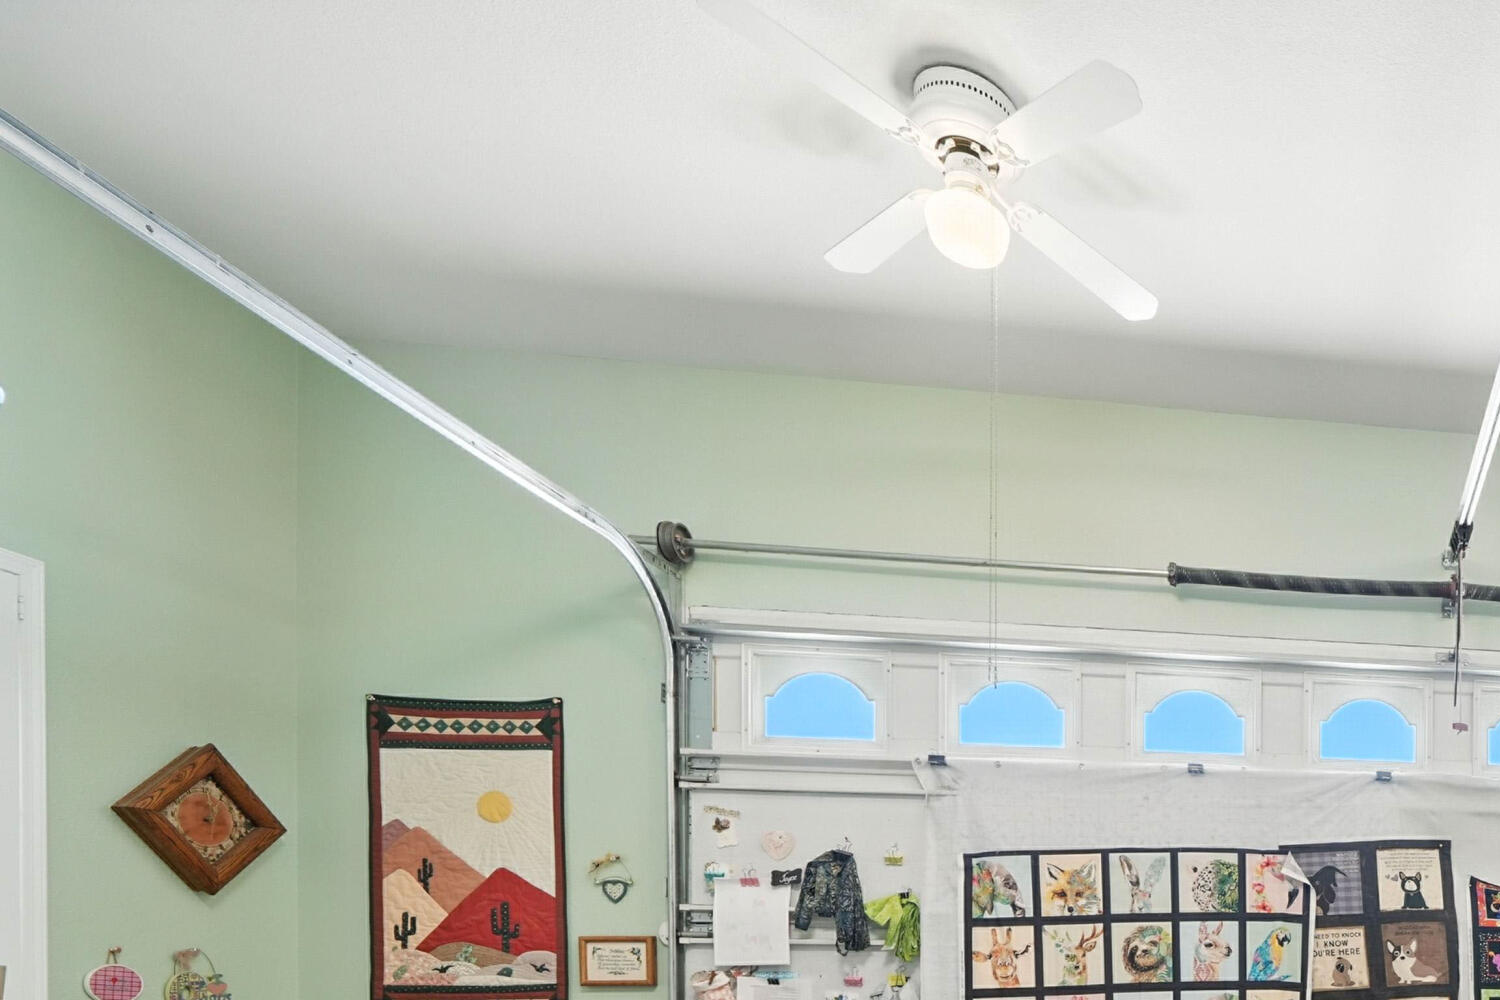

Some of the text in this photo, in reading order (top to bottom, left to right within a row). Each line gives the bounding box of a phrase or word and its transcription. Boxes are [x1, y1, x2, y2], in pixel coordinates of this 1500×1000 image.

[1323, 939, 1348, 948] KNOW
[1313, 947, 1361, 957] OU'RE HERE
